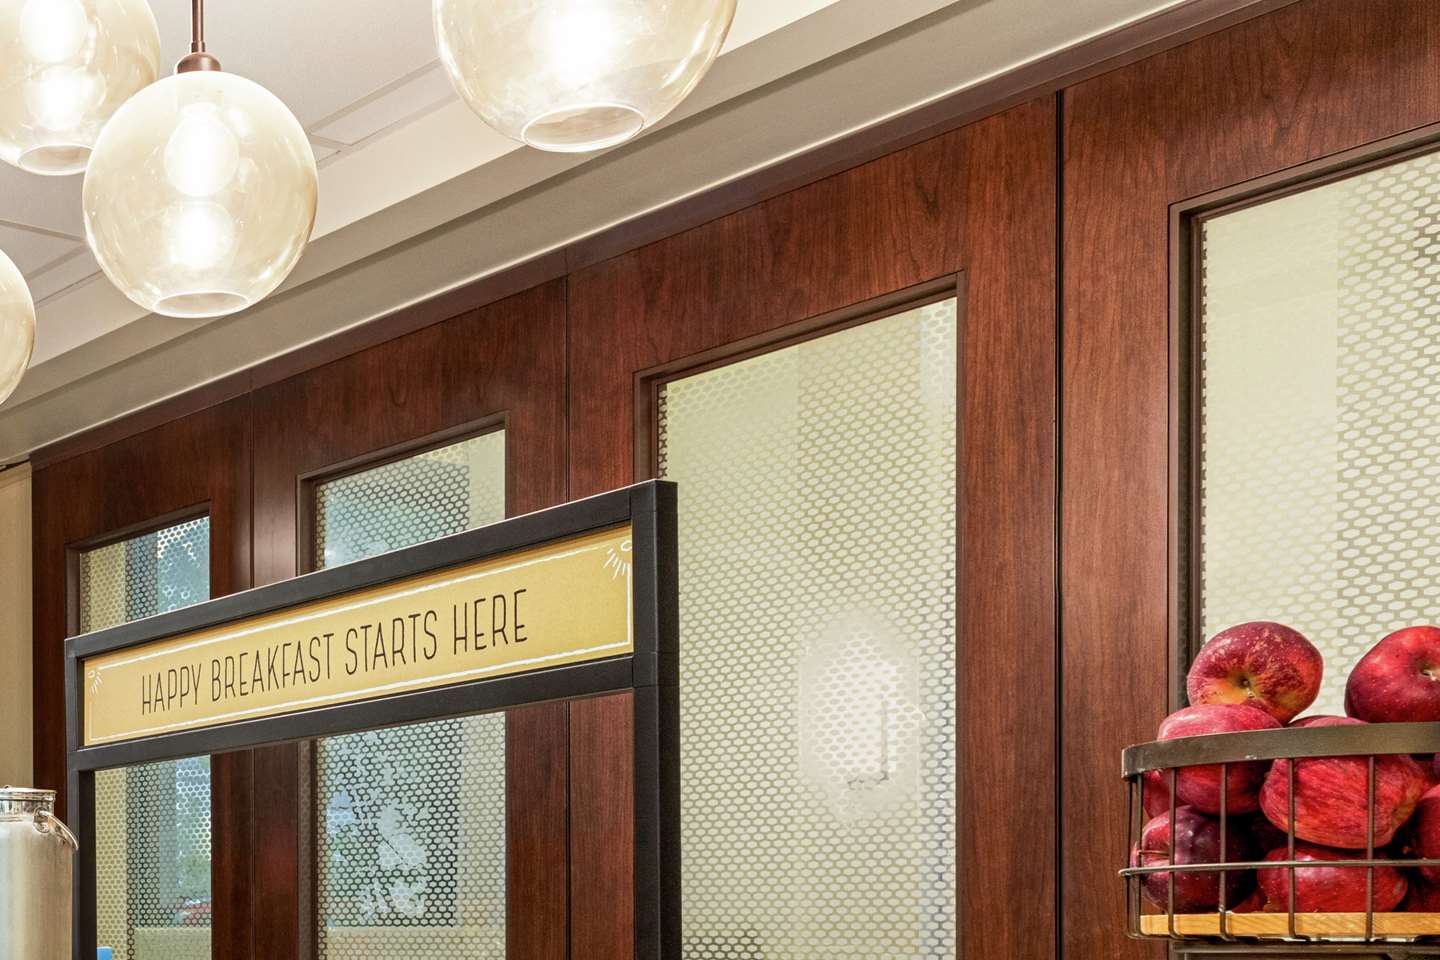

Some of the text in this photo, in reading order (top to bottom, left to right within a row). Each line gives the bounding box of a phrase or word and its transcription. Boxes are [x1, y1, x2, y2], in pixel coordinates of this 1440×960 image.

[141, 588, 528, 716] HAPPY BREAKFAST STARTS HERE
